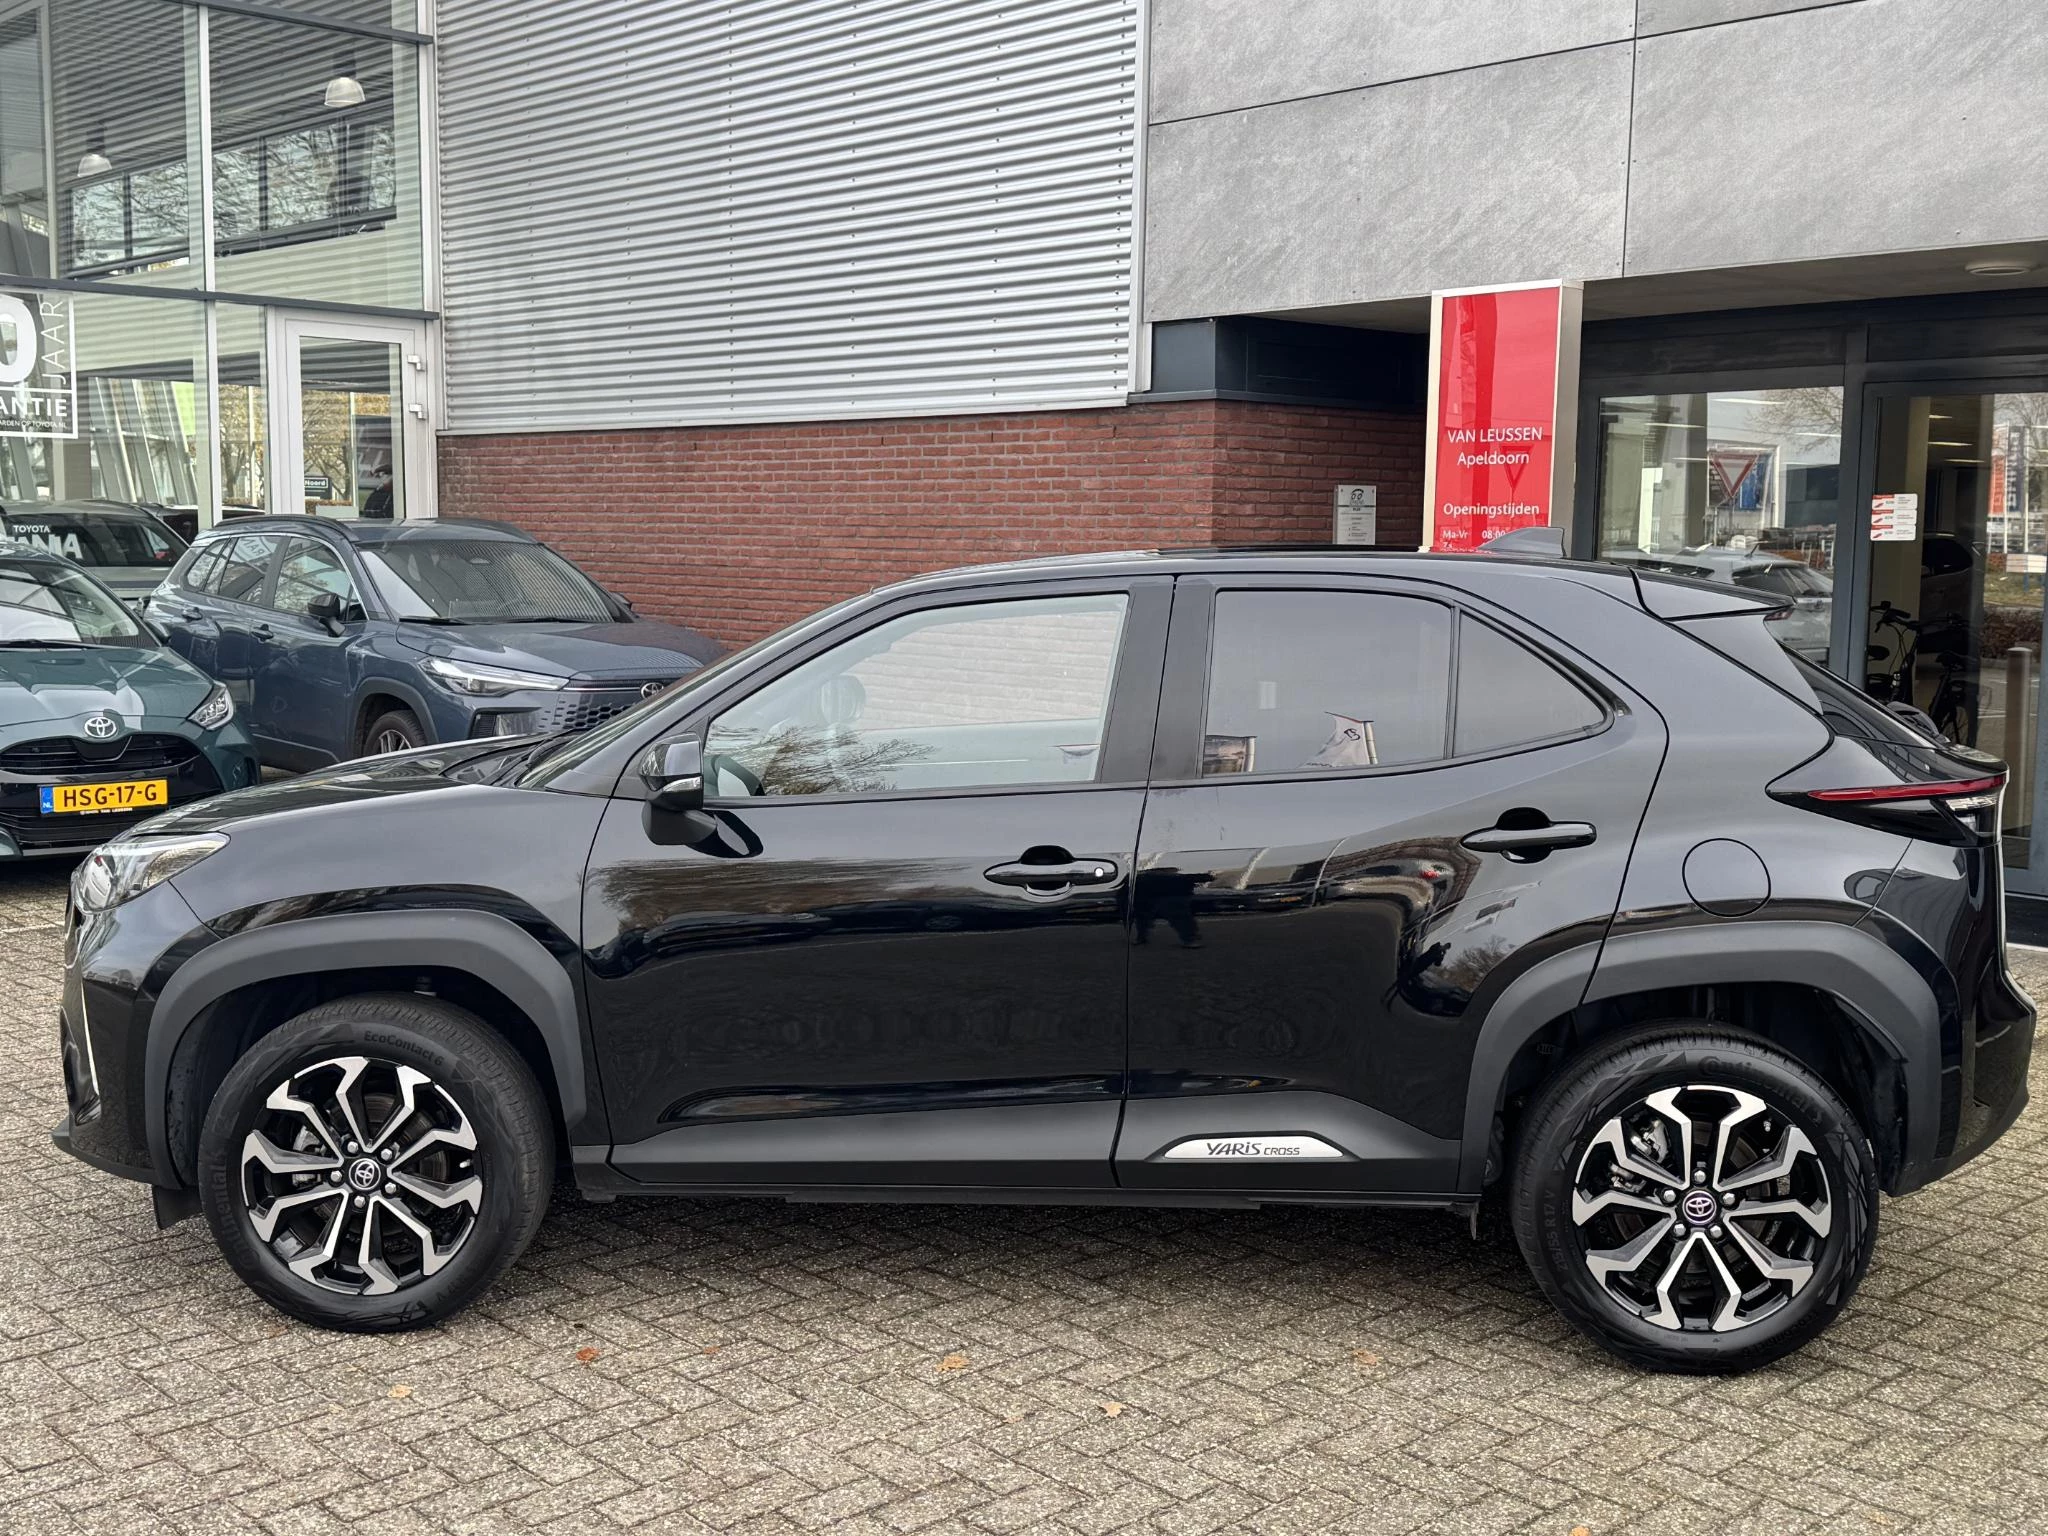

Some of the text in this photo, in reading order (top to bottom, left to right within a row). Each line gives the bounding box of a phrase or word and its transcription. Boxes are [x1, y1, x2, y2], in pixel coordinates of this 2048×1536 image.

[40, 300, 67, 385] JAAR
[1448, 427, 1543, 443] VAN LEUSSEN
[1457, 451, 1529, 469] Apeldoorn
[1443, 503, 1540, 519] Openingstijden
[13, 524, 51, 533] TOYOTA
[1442, 530, 1469, 540] Ma-Vr
[63, 783, 158, 808] HSG-17-G
[43, 801, 53, 809] NL
[364, 1030, 445, 1066] EcoContact 6
[1263, 1147, 1300, 1156] CROSS
